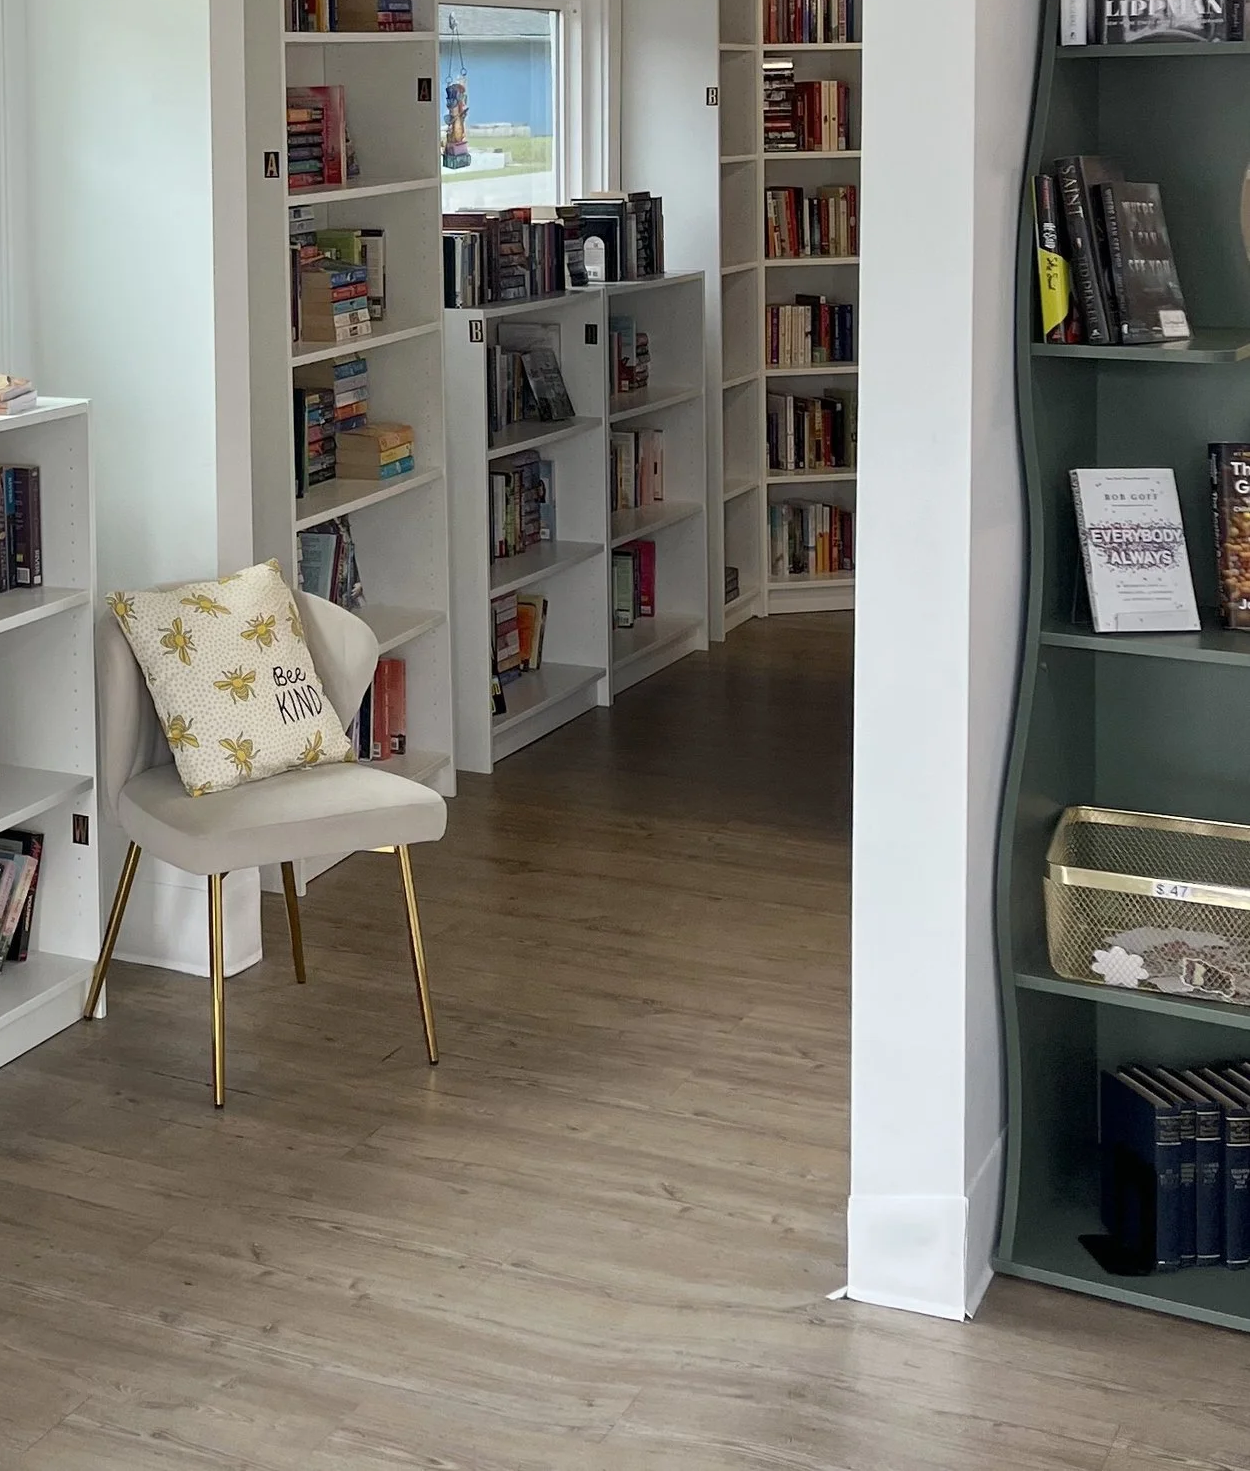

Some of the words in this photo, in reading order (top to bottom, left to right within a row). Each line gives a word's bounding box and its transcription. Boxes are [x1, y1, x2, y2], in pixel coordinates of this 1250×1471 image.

[707, 88, 718, 105] B
[266, 152, 278, 178] A
[1061, 164, 1085, 219] SAINT
[1120, 200, 1155, 215] WHERE
[1127, 259, 1147, 274] SEE
[471, 320, 482, 342] B
[1090, 528, 1184, 544] EVERYBODY
[1110, 549, 1174, 565] ALWAYS
[272, 665, 307, 687] Bee
[275, 684, 323, 725] KIND
